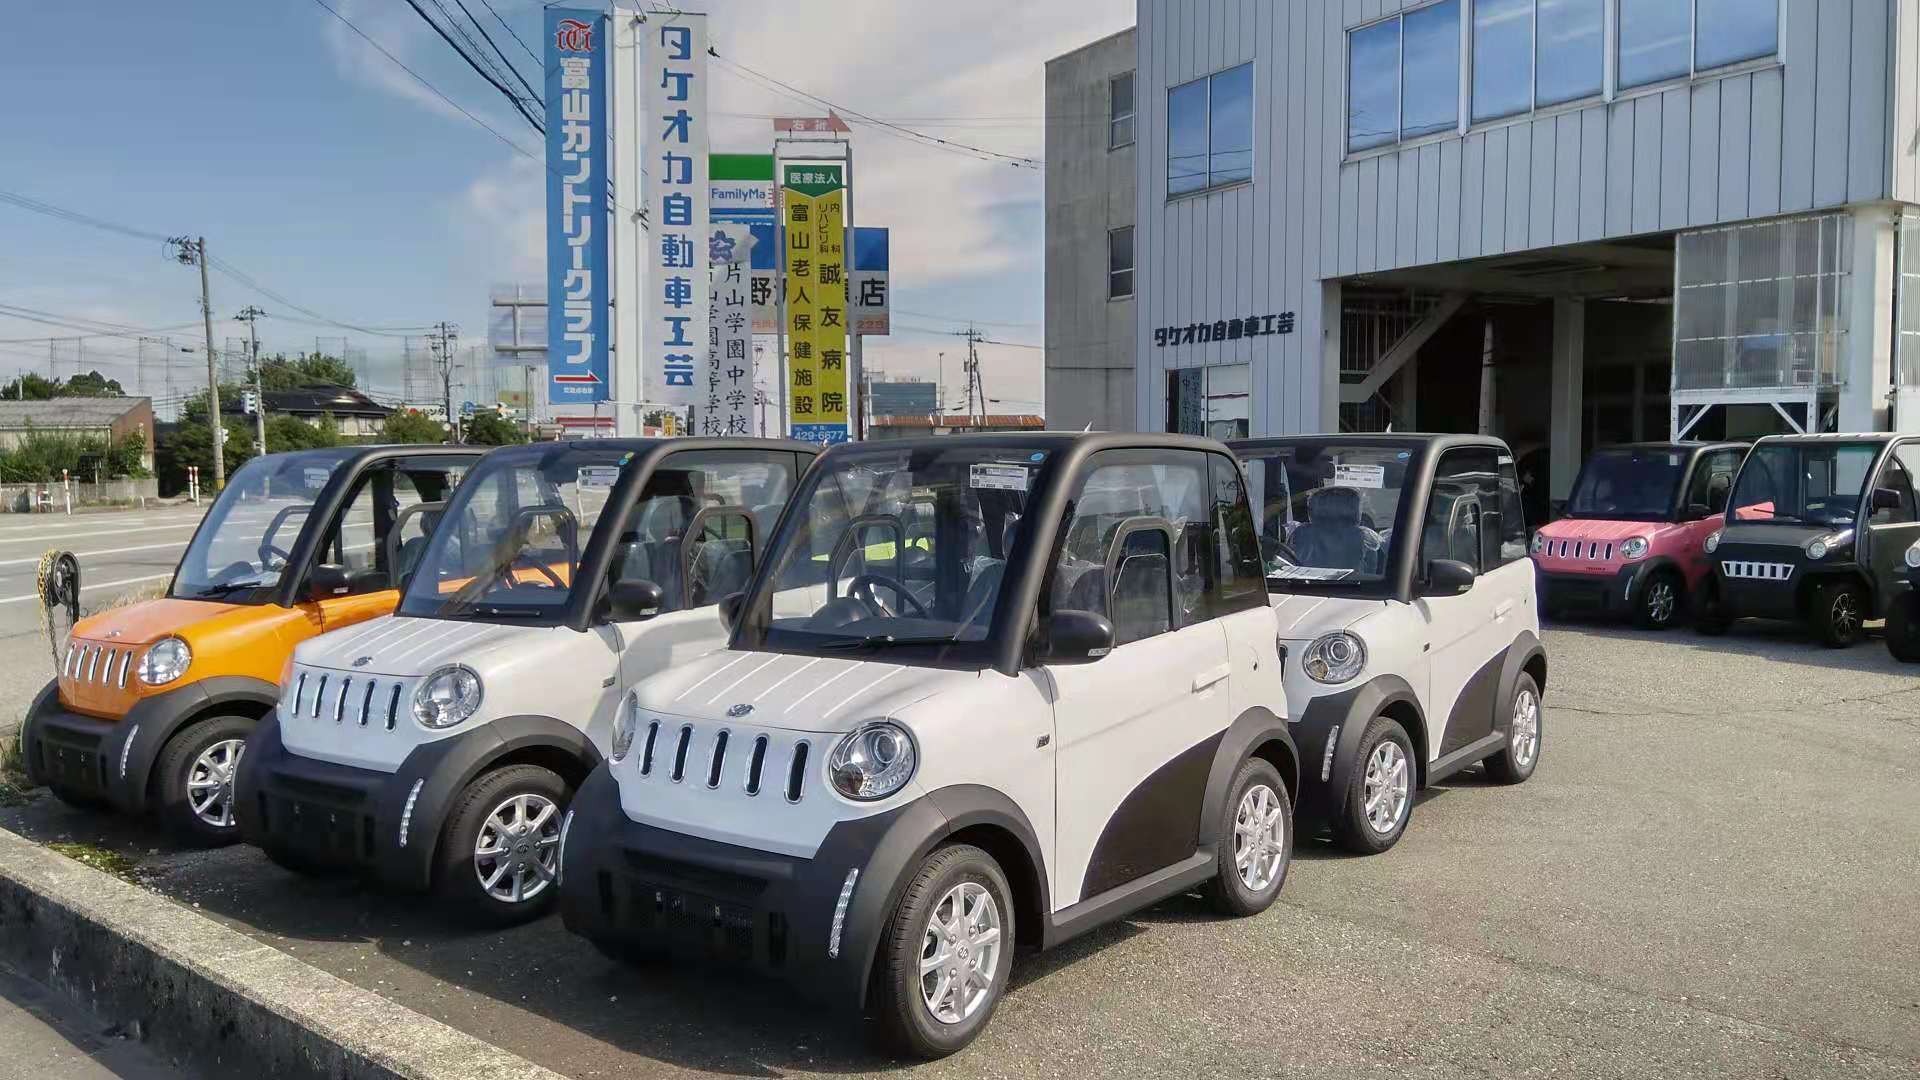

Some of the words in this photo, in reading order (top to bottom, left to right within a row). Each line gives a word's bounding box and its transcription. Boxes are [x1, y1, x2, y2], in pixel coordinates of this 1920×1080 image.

[560, 57, 596, 364] 富山カントリークラブ
[661, 26, 693, 386] タケオカ自動車工芸
[790, 172, 837, 184] 医療法人
[724, 262, 748, 434] 片山学園中学校
[791, 203, 813, 414] 富山老人保健施設
[819, 262, 843, 412] 誠友病院
[1154, 311, 1295, 347] タケオカ自動車工芸
[794, 431, 844, 440] 429-6677
